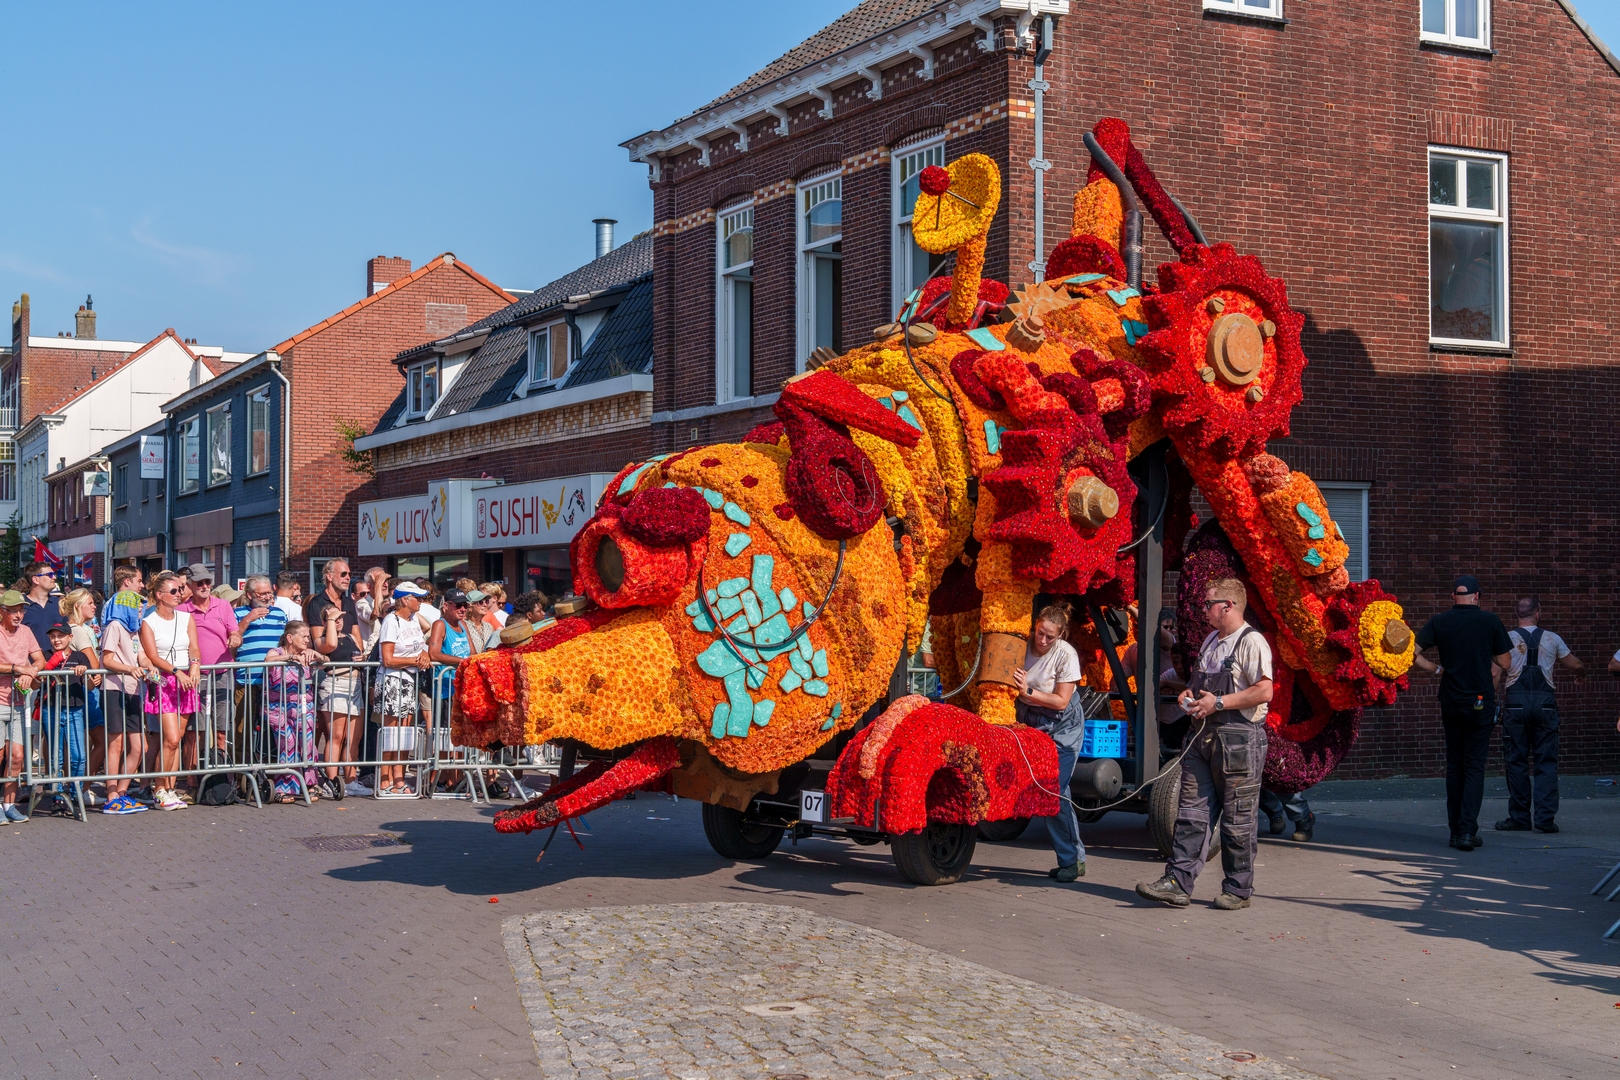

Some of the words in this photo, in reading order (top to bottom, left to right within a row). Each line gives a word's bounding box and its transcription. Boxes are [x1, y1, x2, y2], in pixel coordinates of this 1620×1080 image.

[396, 508, 429, 544] LUCK
[489, 495, 539, 538] SUSHI
[804, 794, 822, 811] 07
